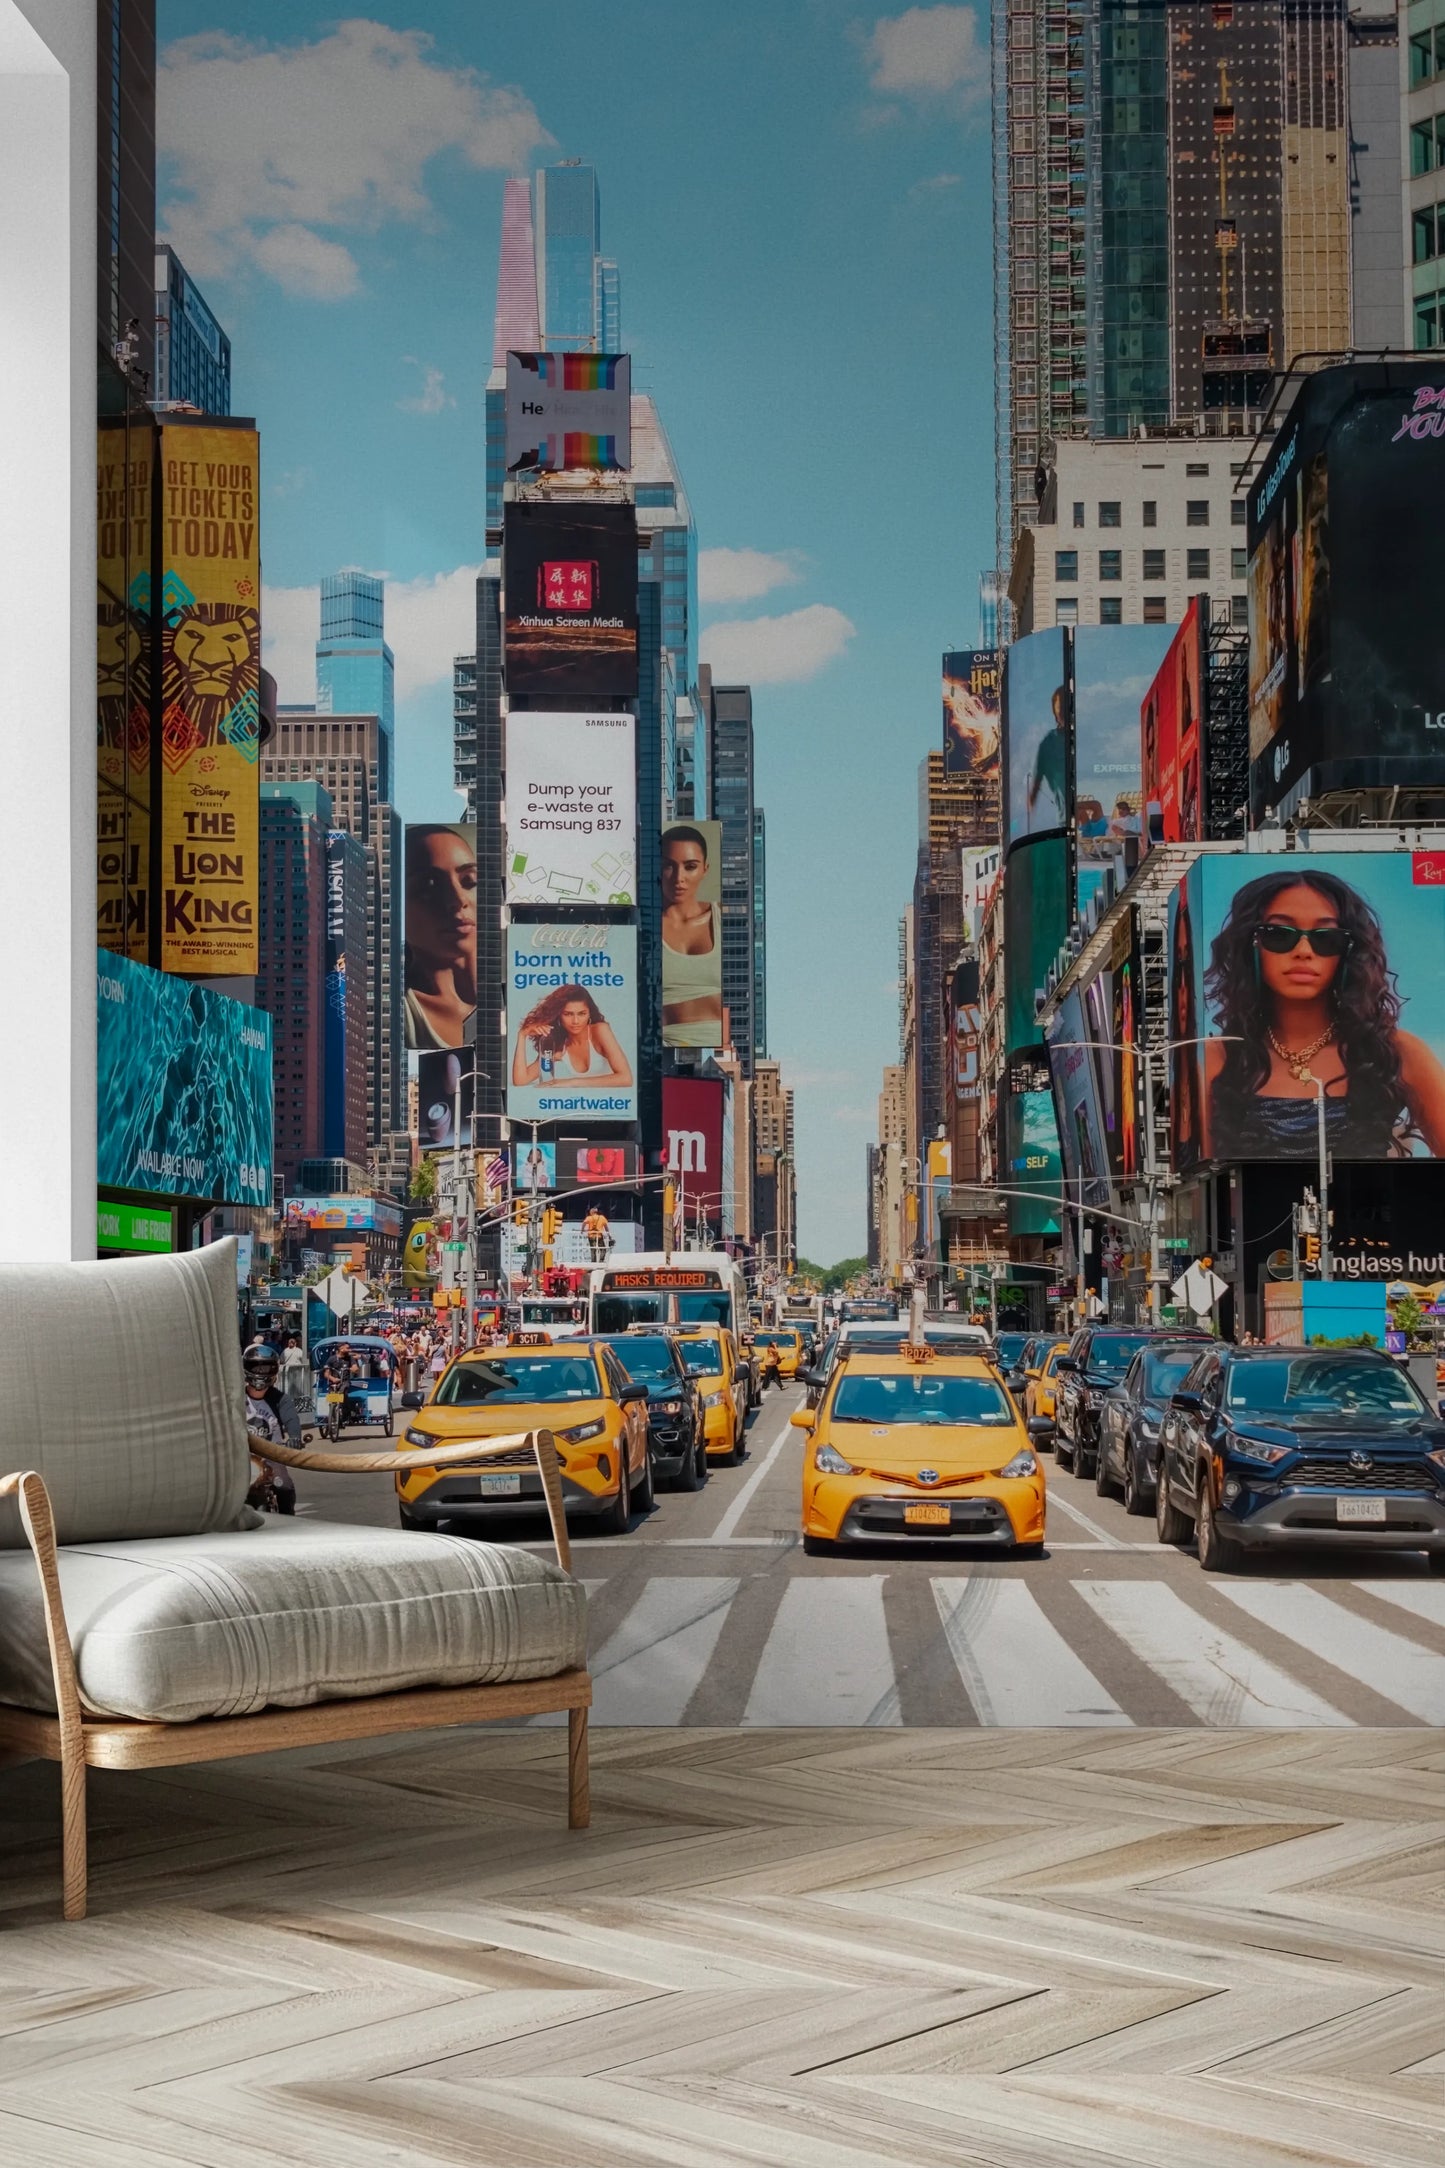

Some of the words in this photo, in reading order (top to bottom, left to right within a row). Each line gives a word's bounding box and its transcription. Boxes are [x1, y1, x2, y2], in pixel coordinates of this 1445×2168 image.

[522, 402, 543, 415] He
[168, 460, 198, 487] GET
[206, 463, 252, 490] YOUR
[167, 487, 253, 520] TICKETS
[167, 519, 254, 559] TODAY
[519, 615, 553, 627] Xinhua
[556, 617, 589, 627] Screen
[593, 617, 624, 628] Media
[188, 783, 230, 800] Disney
[528, 783, 574, 796] Dump
[579, 785, 613, 797] your
[527, 802, 594, 813] e-waste
[597, 802, 614, 813] at
[183, 812, 235, 835] THE
[520, 819, 593, 834] Samsung
[597, 820, 621, 830] 837
[174, 844, 243, 885] LION
[165, 890, 253, 935] KING
[183, 941, 254, 949] AWARD-WINNING
[514, 951, 562, 967] born
[568, 951, 611, 968] with
[514, 972, 568, 989] great
[573, 972, 624, 986] taste
[539, 1097, 631, 1110] smartwater
[667, 1129, 707, 1173] m
[137, 1149, 182, 1177] AVAILABLE
[183, 1158, 205, 1180] NOW
[1026, 1155, 1049, 1169] SELF
[1306, 1251, 1403, 1278] snglass
[1409, 1251, 1445, 1273] hut
[615, 1274, 650, 1286] MASKS
[654, 1273, 706, 1286] REQUIRED
[519, 1334, 538, 1344] 3C17
